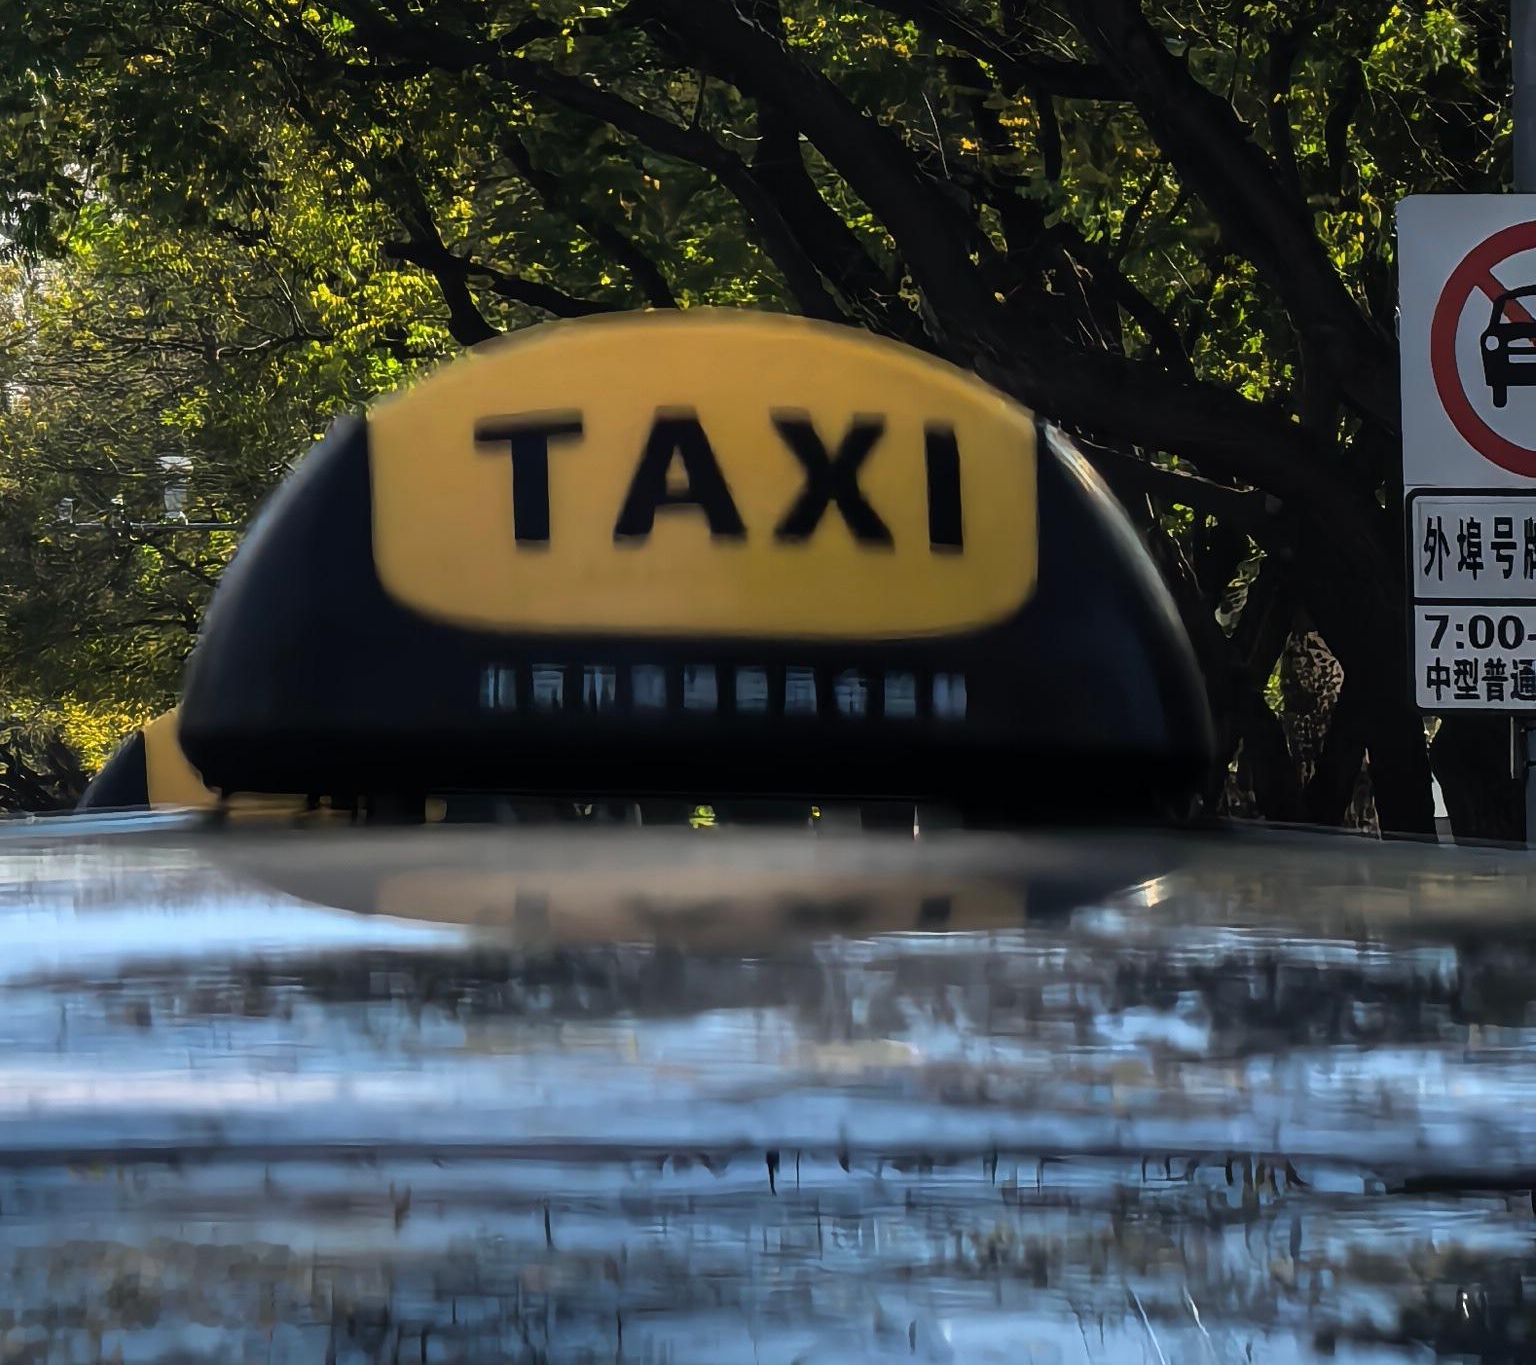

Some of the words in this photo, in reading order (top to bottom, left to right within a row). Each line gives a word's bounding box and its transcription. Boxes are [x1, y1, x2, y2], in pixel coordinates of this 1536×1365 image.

[474, 406, 964, 554] TAXI
[1426, 656, 1536, 702] 中型普通
